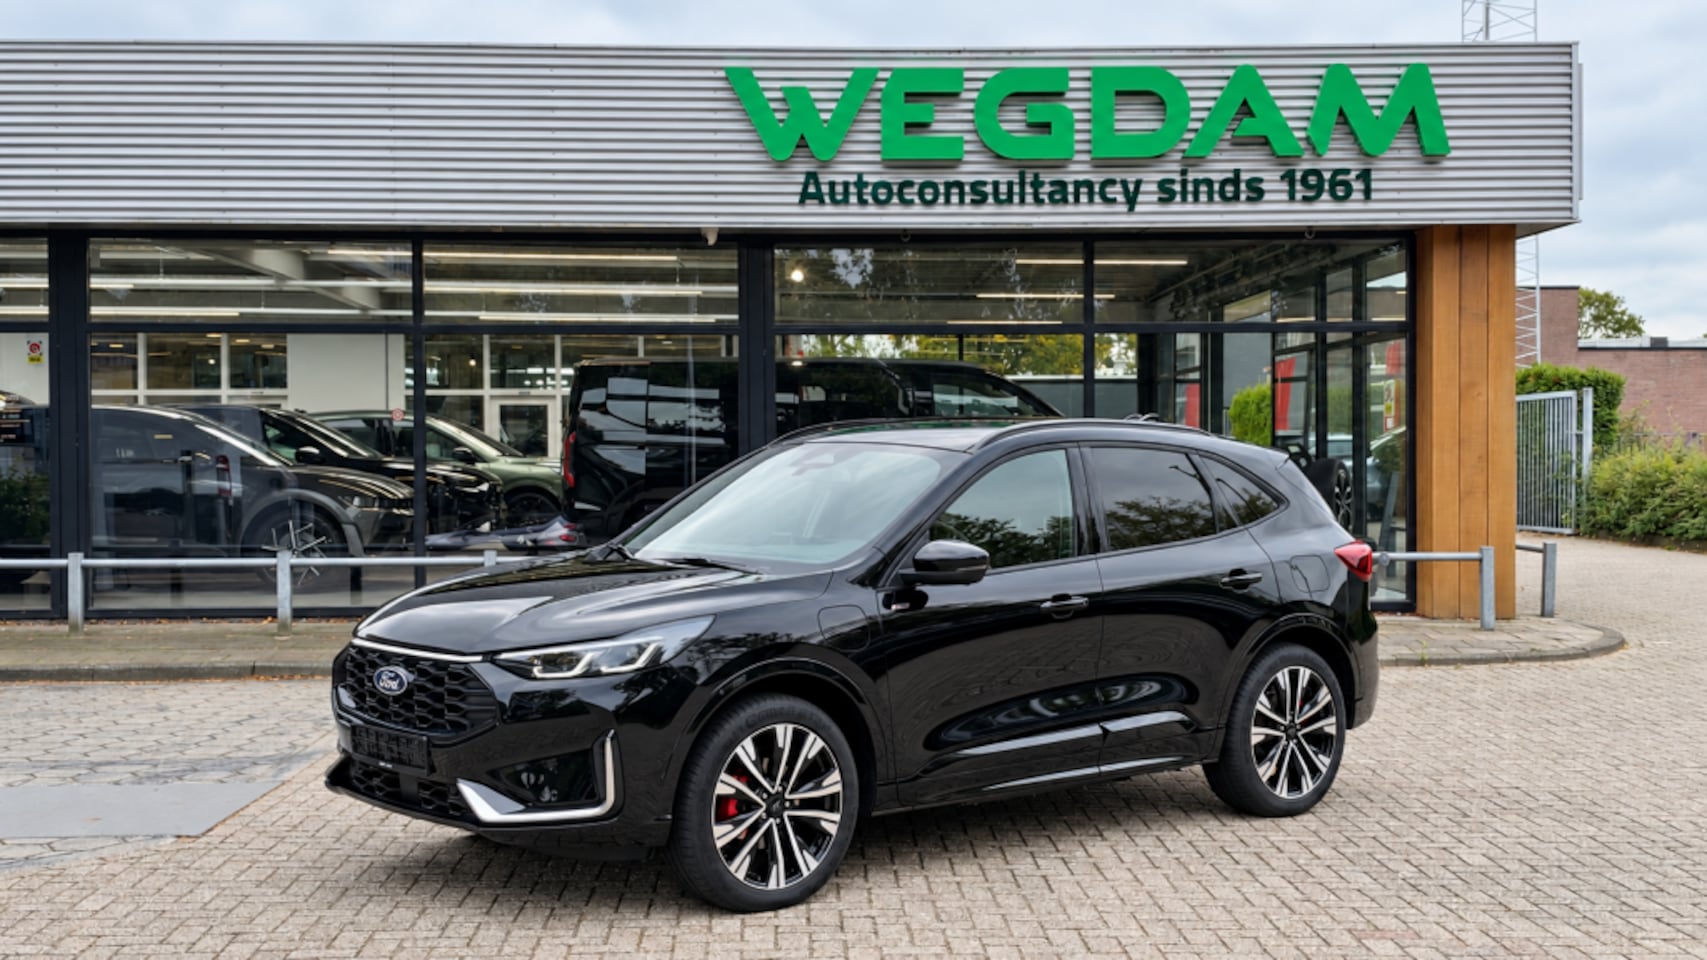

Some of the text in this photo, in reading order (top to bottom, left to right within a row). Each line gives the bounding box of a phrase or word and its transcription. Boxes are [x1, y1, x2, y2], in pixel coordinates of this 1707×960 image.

[725, 63, 1451, 160] WEGDAM
[799, 168, 1372, 212] Autoconsultancy sinds 1961
